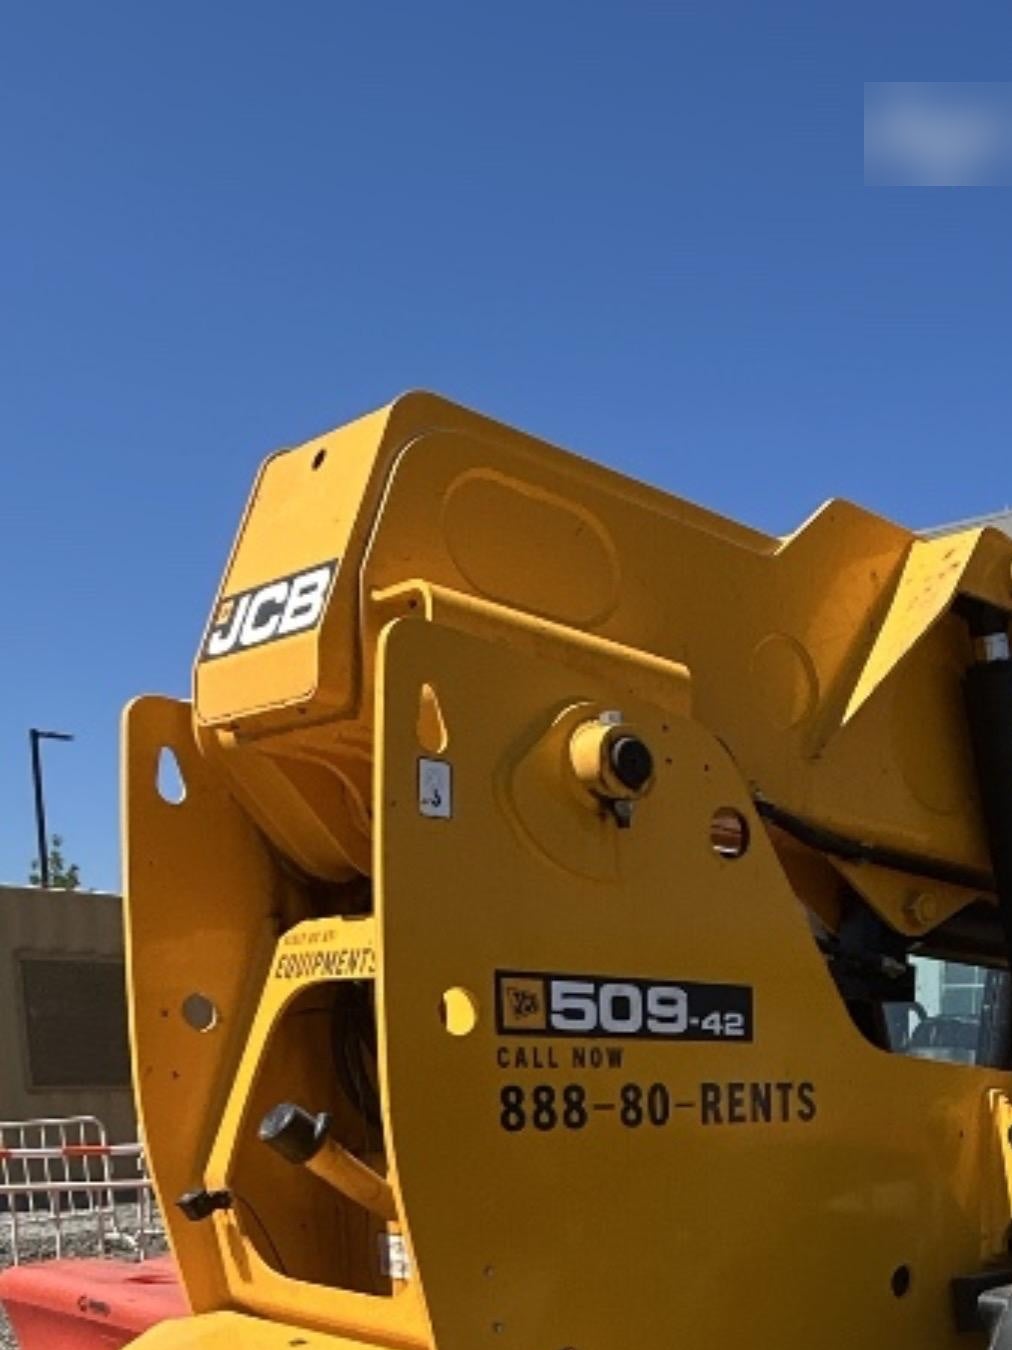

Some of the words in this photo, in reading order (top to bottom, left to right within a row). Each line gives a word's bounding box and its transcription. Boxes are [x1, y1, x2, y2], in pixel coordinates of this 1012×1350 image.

[207, 565, 331, 656] JCB
[550, 980, 745, 1036] 509-42
[497, 1047, 558, 1069] CALL
[572, 1047, 624, 1069] NOW
[500, 1082, 817, 1132] 888-80-RENTS
